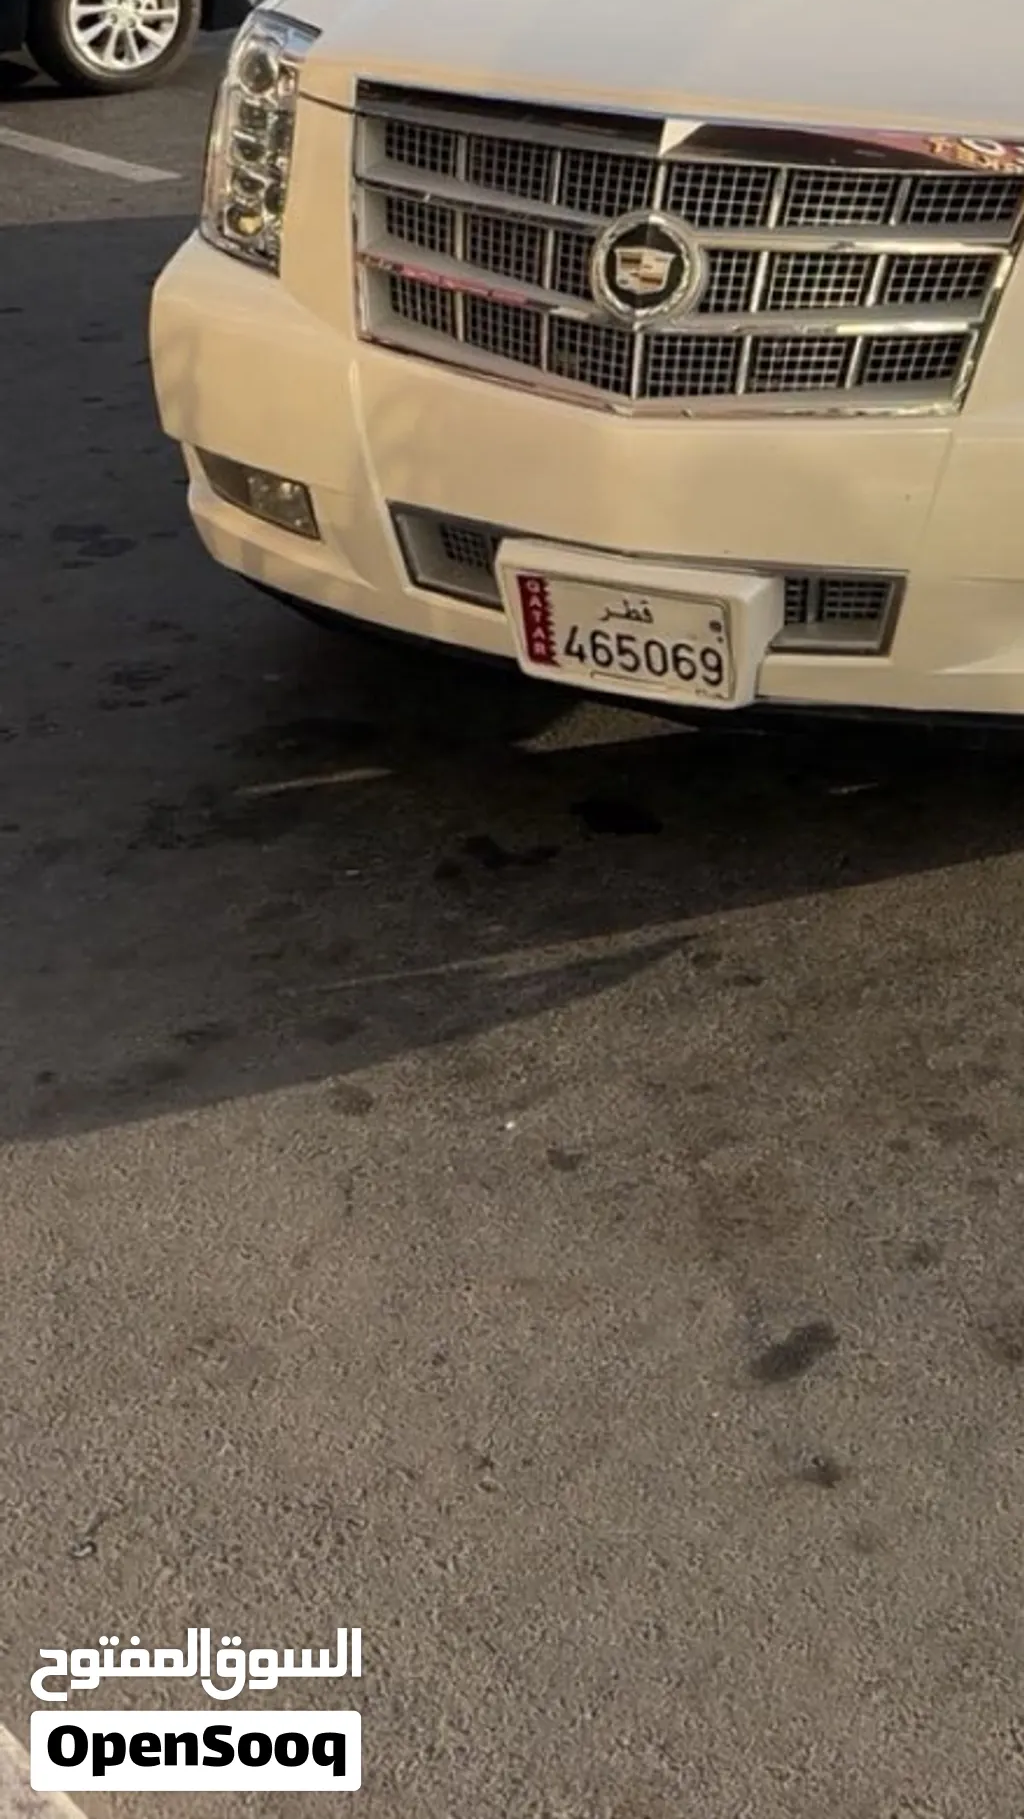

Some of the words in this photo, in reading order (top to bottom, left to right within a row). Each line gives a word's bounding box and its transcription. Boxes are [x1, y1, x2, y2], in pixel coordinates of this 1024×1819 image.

[526, 579, 548, 656] QATAR
[599, 598, 654, 624] قطر
[563, 625, 725, 687] 465069
